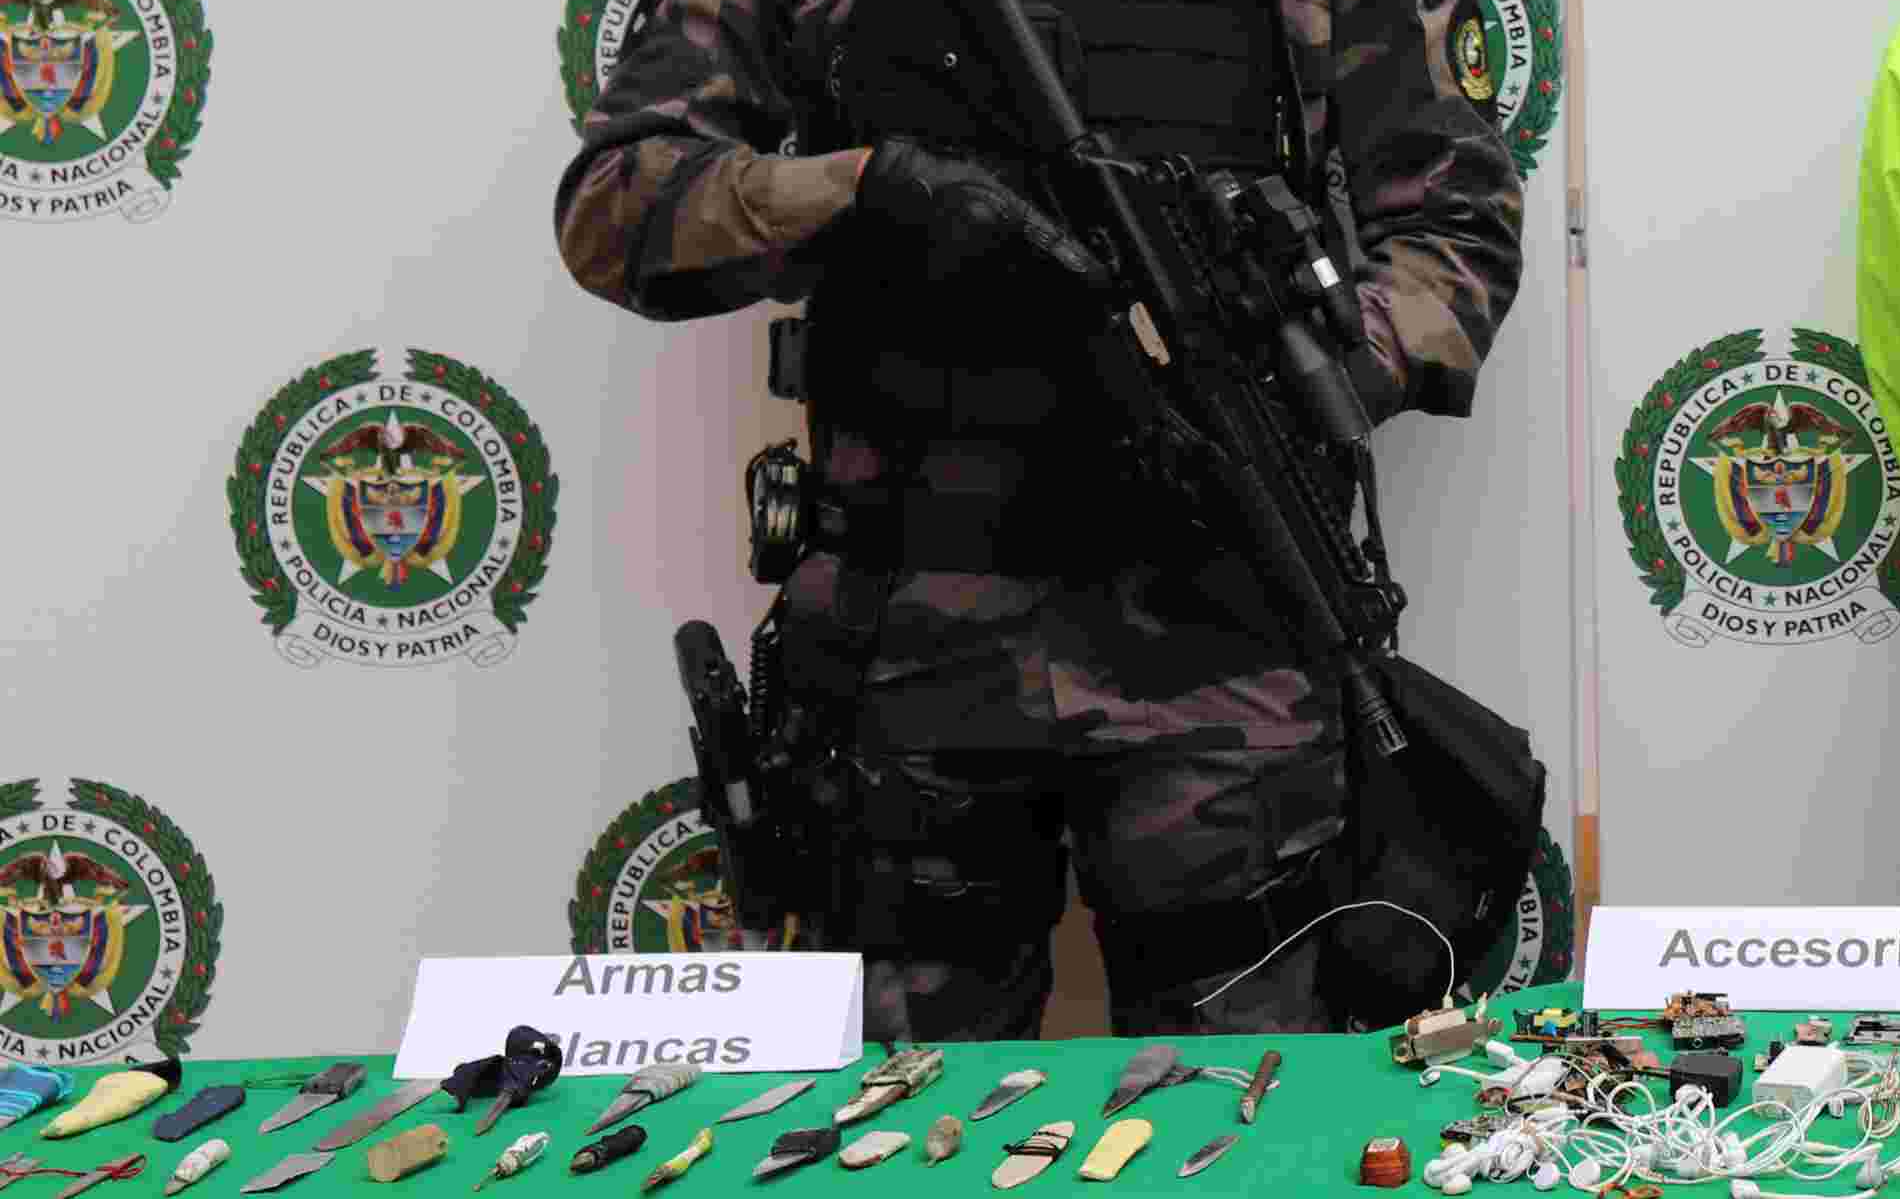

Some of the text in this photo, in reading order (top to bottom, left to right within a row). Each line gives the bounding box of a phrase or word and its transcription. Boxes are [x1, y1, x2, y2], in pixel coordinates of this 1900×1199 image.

[51, 110, 160, 184] NACIONAL
[50, 180, 133, 215] PATRIA
[271, 385, 517, 526] REPUBLICA DE COLOMBIA
[1659, 378, 1738, 506] REPUBLICA
[1765, 365, 1799, 381] DE
[287, 553, 508, 629] POLICIA NACIONAL
[1674, 531, 1896, 606] POLICIA NACIONAL
[397, 623, 481, 658] PATRIA
[1785, 600, 1867, 637] PATRIA
[42, 815, 182, 953] DE COLOMBIA
[612, 821, 692, 949] REPUBLICA
[553, 955, 742, 996] Armas
[57, 981, 171, 1060] NACIONAL
[544, 1031, 753, 1068] lancas
